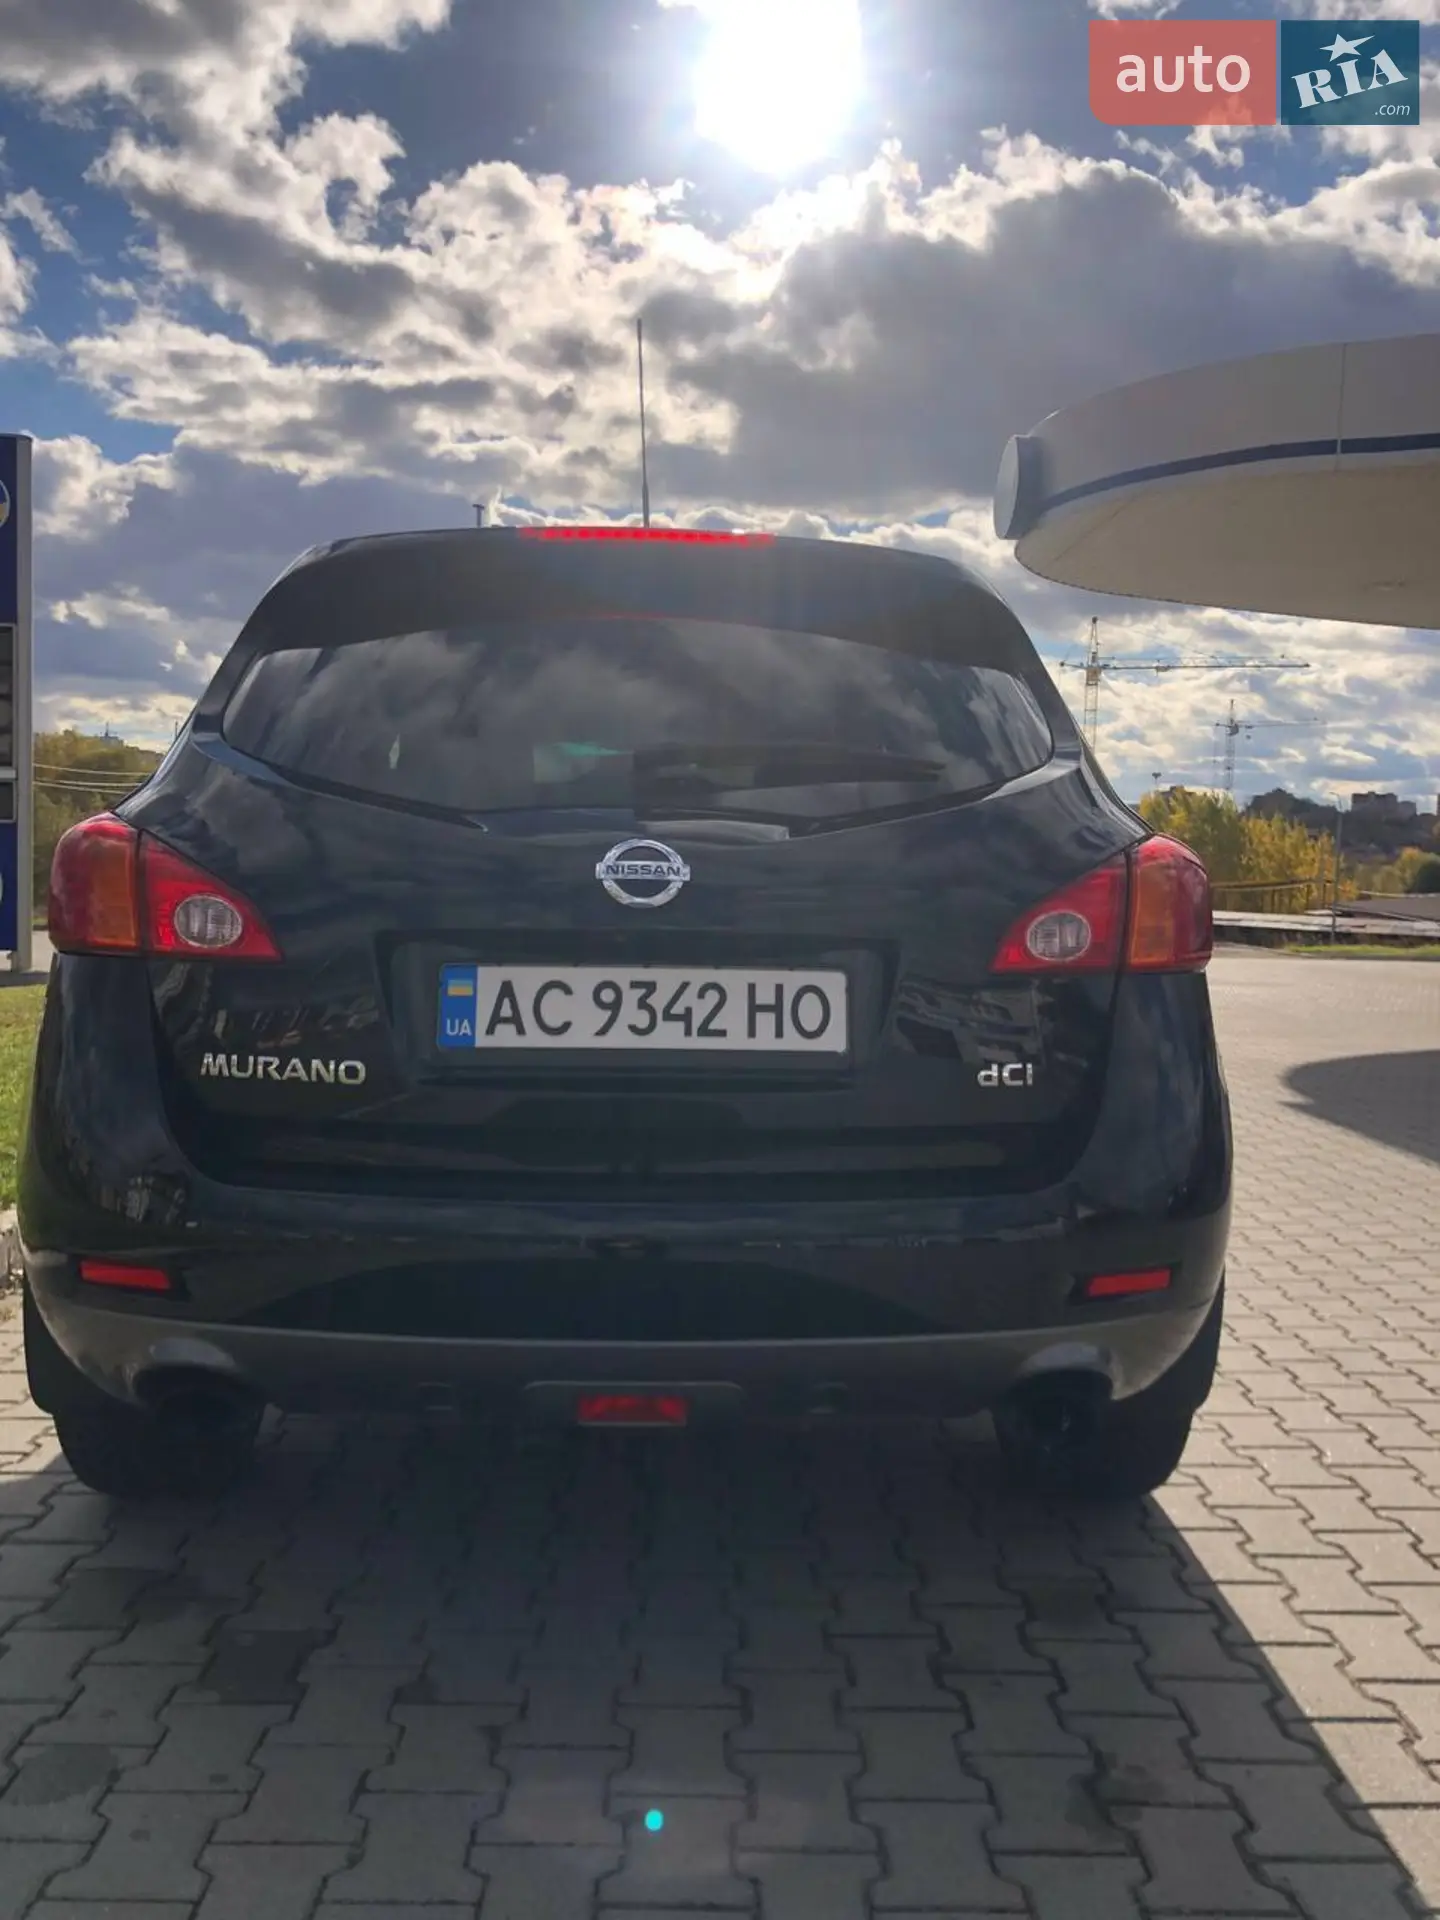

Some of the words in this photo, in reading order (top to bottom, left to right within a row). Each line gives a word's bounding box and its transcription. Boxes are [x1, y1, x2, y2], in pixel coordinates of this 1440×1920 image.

[606, 864, 681, 877] NISSAN
[485, 980, 574, 1037] AC
[592, 980, 728, 1038] 9342
[747, 982, 831, 1040] HO
[446, 1018, 473, 1037] UA
[200, 1052, 367, 1086] MURANO
